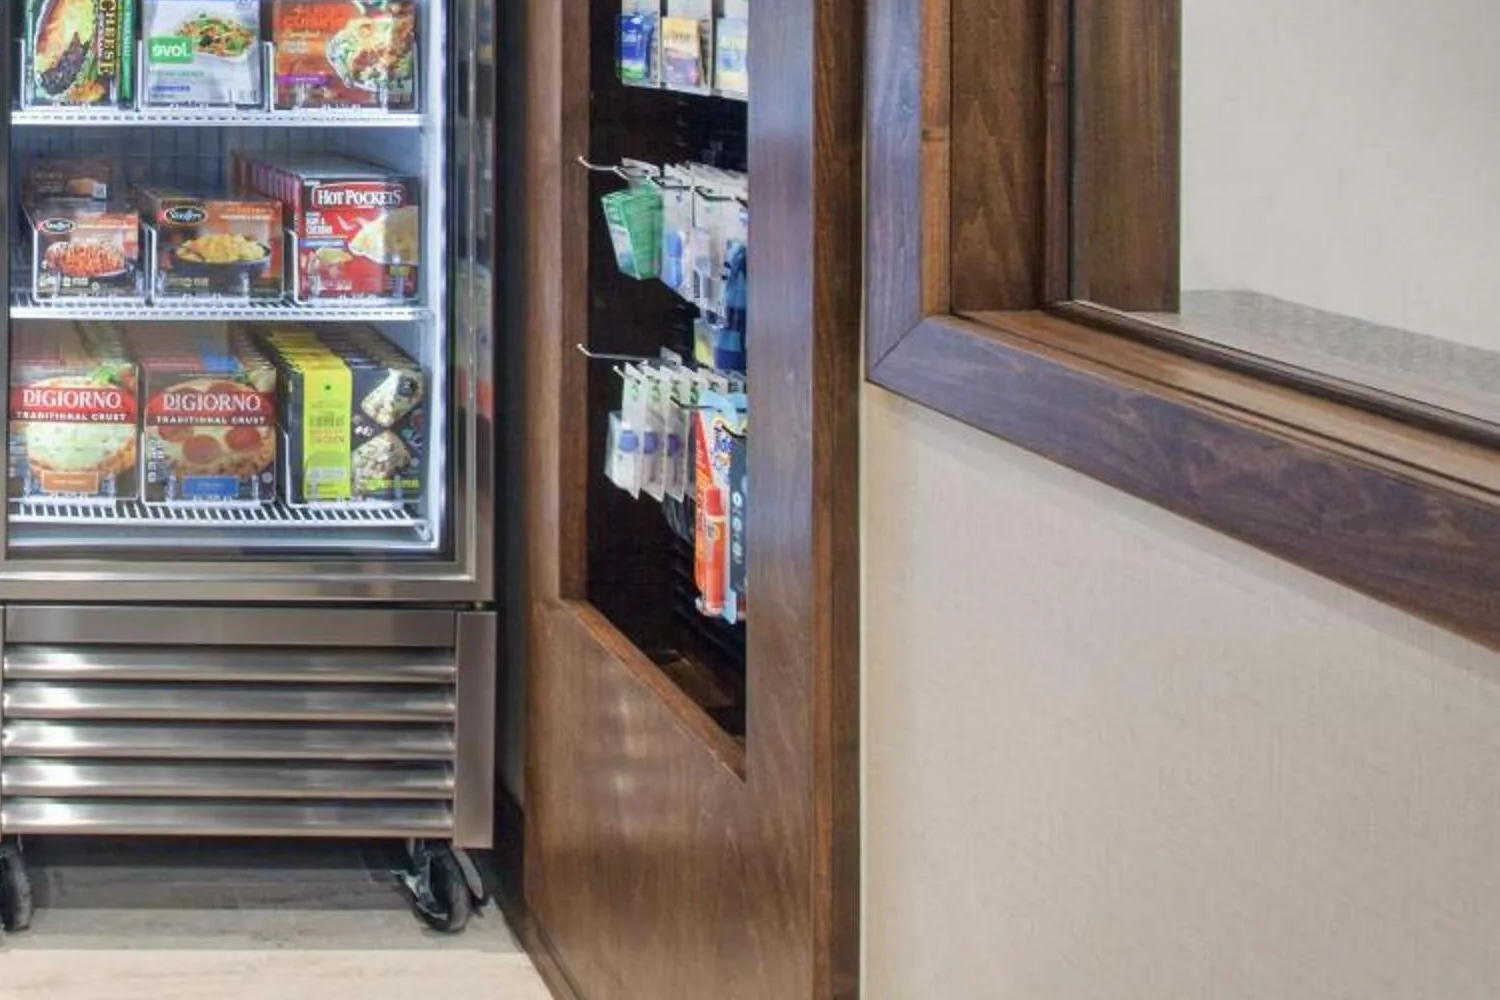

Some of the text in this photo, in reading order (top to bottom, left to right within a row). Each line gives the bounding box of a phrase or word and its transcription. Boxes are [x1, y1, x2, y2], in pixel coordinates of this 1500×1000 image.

[317, 189, 404, 206] HOT POCKETS
[22, 388, 122, 409] DIGIORNO
[163, 392, 261, 411] DIGIORNO
[16, 411, 127, 421] TRADITIONAL CRUST
[156, 415, 266, 425] TRADITIONAL CRUST
